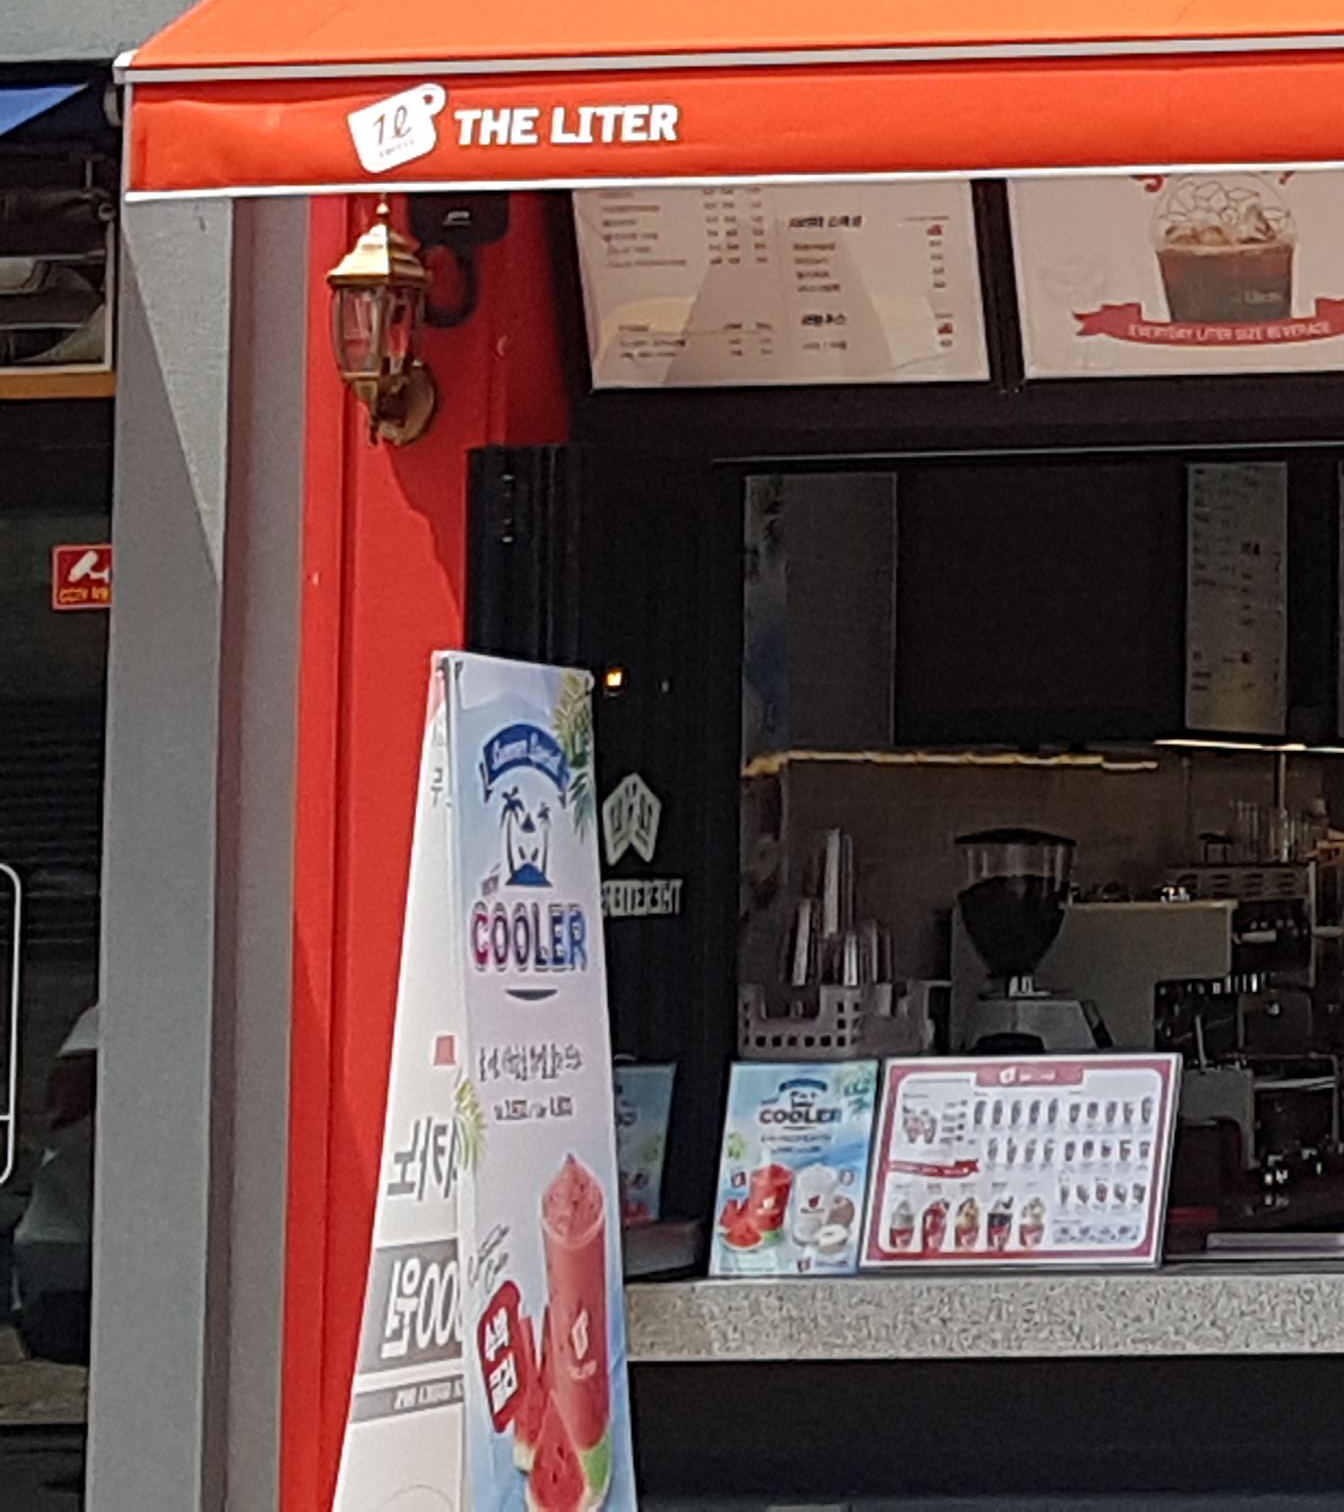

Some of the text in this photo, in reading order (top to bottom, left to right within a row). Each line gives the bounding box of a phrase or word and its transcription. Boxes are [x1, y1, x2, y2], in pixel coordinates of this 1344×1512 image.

[453, 104, 679, 146] THE LITER
[472, 901, 588, 973] COOLER
[758, 1108, 842, 1125] COOLER
